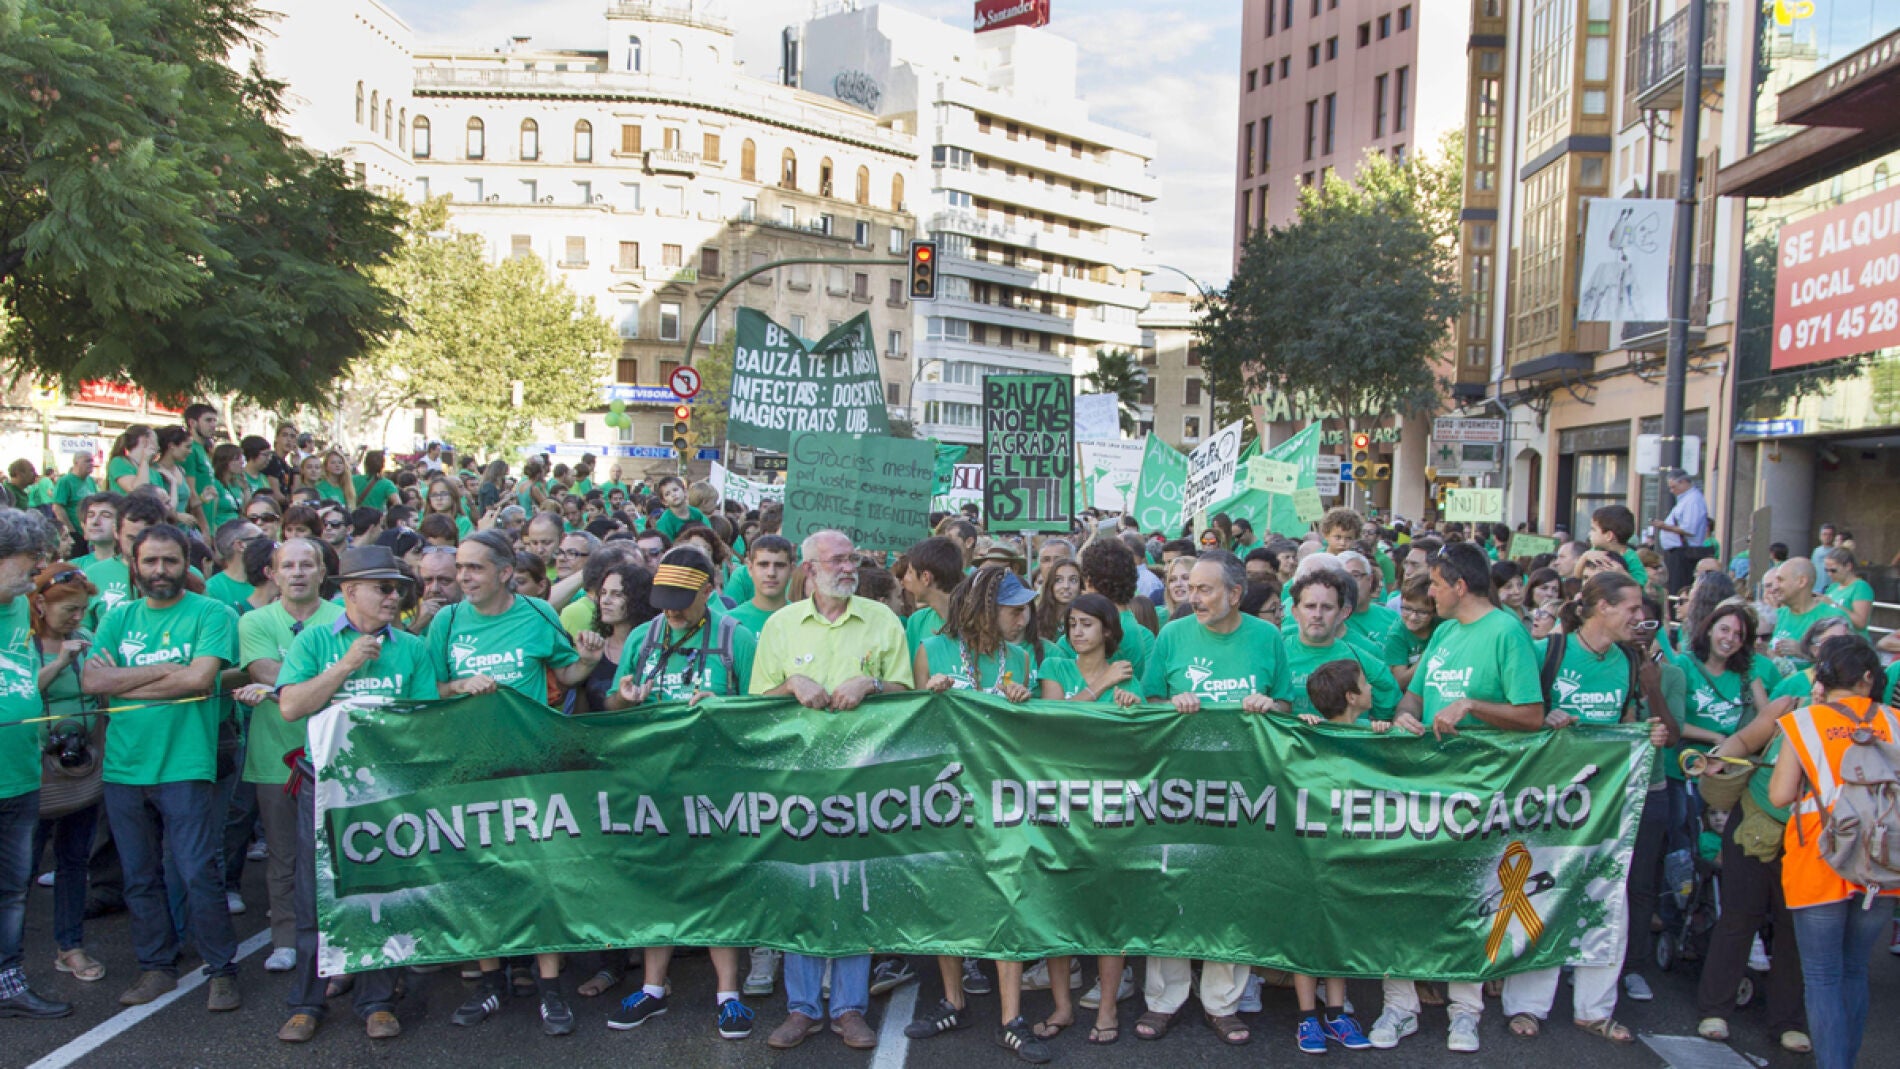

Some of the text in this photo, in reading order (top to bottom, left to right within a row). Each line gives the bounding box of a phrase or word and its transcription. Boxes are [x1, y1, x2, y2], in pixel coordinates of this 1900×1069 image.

[988, 0, 1035, 25] Santander
[1783, 230, 1814, 268] SE
[1790, 253, 1899, 307] LOCAL 400
[1795, 298, 1899, 349] 971 45 28
[735, 346, 802, 378] BAUZÁ
[808, 354, 826, 378] TE
[833, 352, 850, 378] LA
[989, 431, 1070, 455] AGRADA
[135, 642, 192, 666] CRIDA!
[466, 648, 525, 669] CRIDA!
[344, 673, 403, 694] CRIDA!
[1203, 674, 1257, 695] CRIDA!
[1571, 688, 1622, 708] CRIDA!
[342, 793, 582, 866] CONTRA
[598, 791, 669, 837] LA
[992, 777, 1278, 833] DEFENSEM
[1295, 764, 1599, 841] L'EDUCACIÓ
